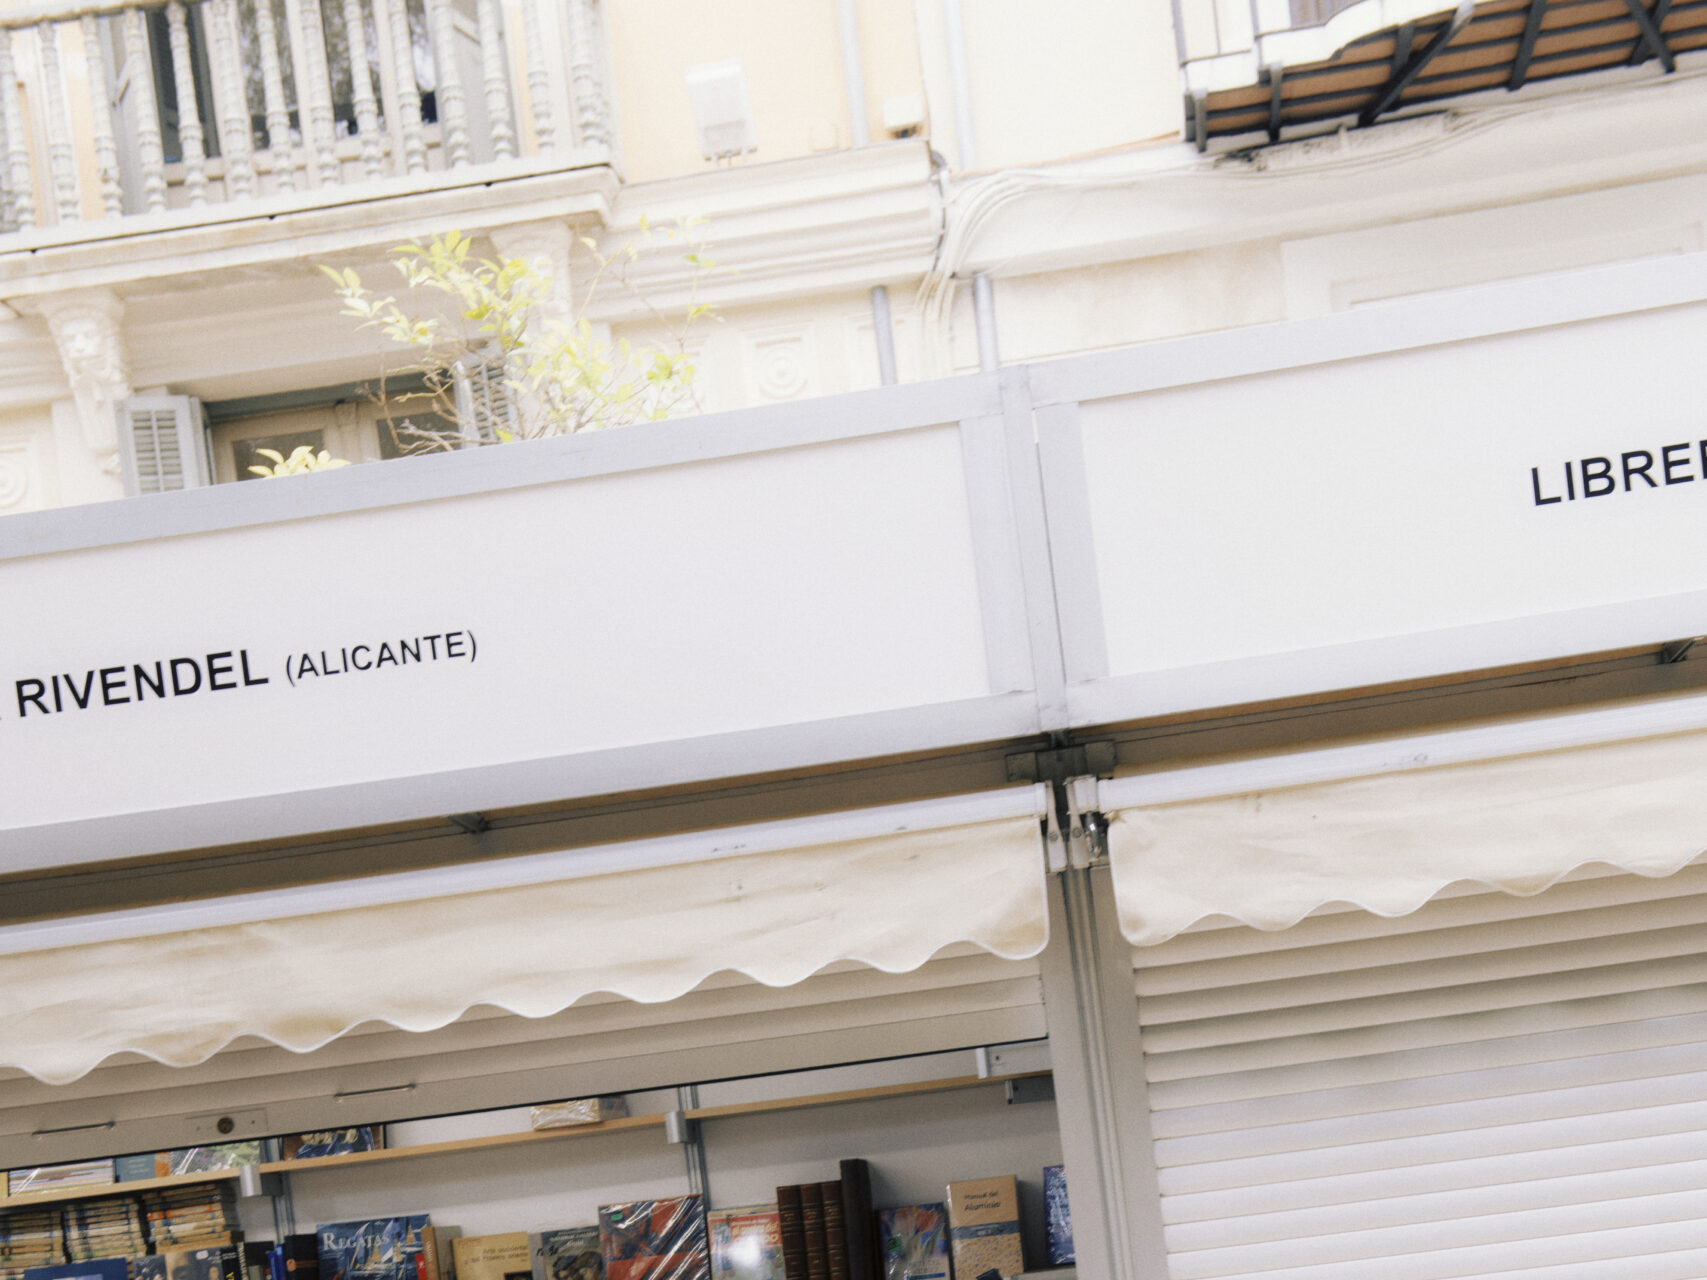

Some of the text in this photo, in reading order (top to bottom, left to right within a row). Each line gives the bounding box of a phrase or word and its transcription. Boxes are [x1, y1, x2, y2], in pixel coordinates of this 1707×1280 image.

[1531, 439, 1707, 507] LIBRE
[15, 629, 478, 718] RIVENDEL (ALICANTE)
